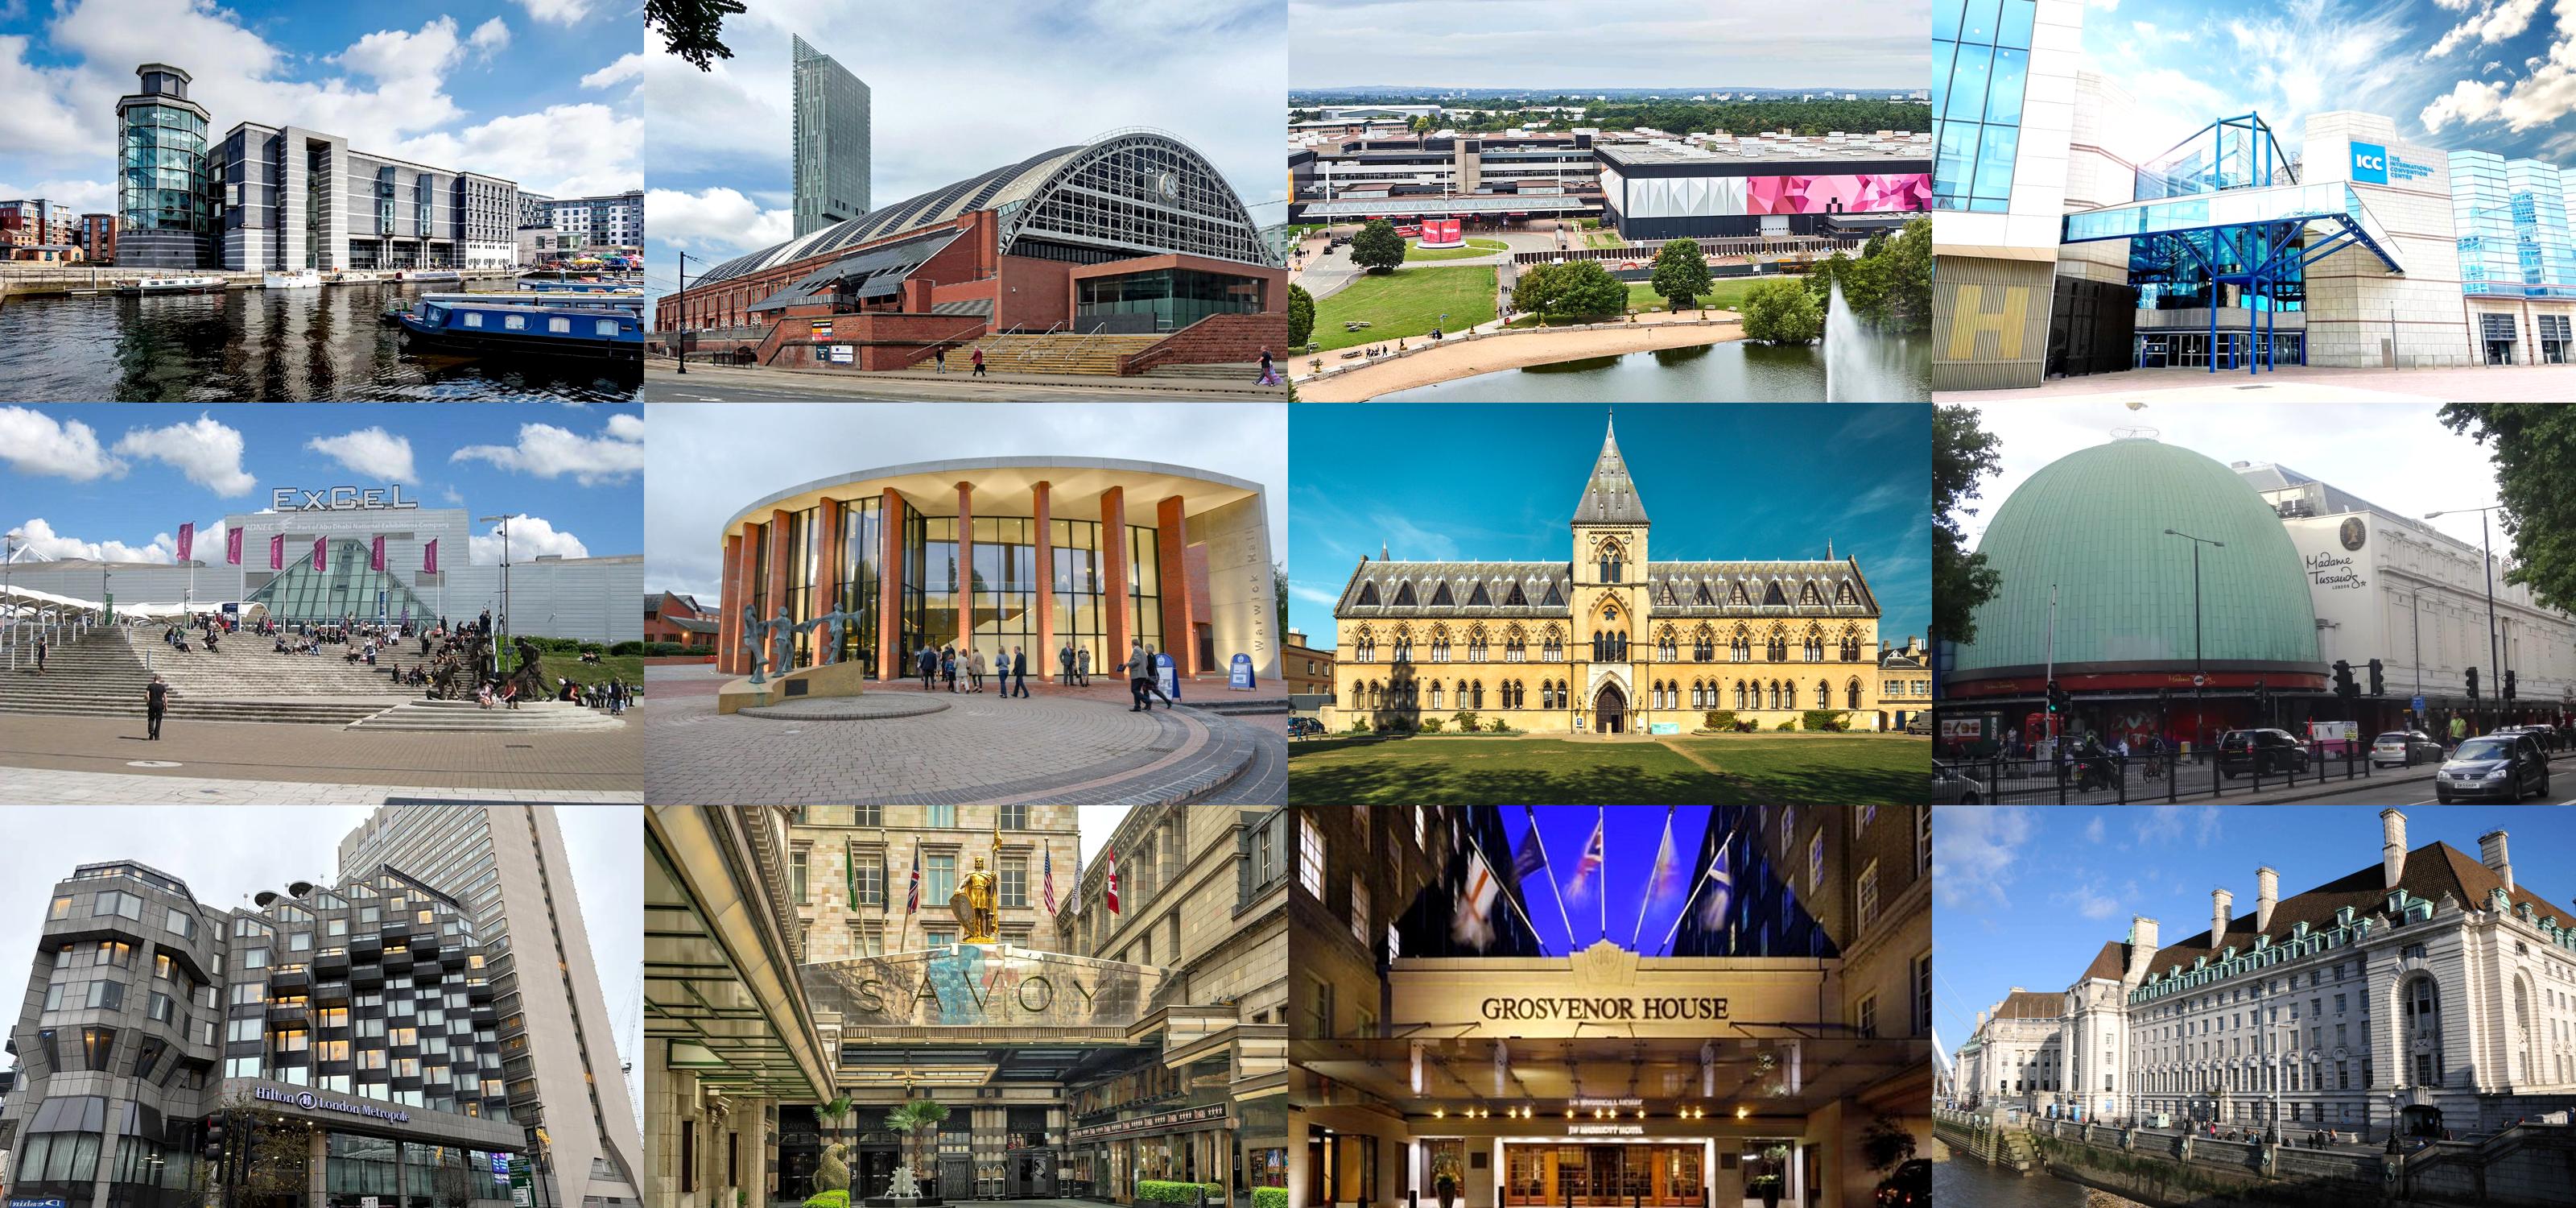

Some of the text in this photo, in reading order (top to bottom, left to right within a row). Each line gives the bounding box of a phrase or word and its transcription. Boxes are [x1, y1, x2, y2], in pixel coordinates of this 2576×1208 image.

[2356, 154, 2383, 171] ICC
[2389, 160, 2434, 172] INTERNATIONAL
[2390, 167, 2428, 177] CONVENTION
[2390, 172, 2413, 180] CENTRE
[1948, 284, 2029, 360] H
[2306, 552, 2354, 569] Madame
[2308, 566, 2360, 590] Tussauds
[1245, 530, 1264, 652] Warwick Hall
[859, 970, 1107, 1013] SAVOY
[1482, 998, 1729, 1020] GROSVENOR HOUSE
[255, 1086, 295, 1104] Hilton
[318, 1097, 360, 1115] London
[362, 1104, 411, 1124] Metropole
[1011, 1122, 1042, 1130] SAVOY
